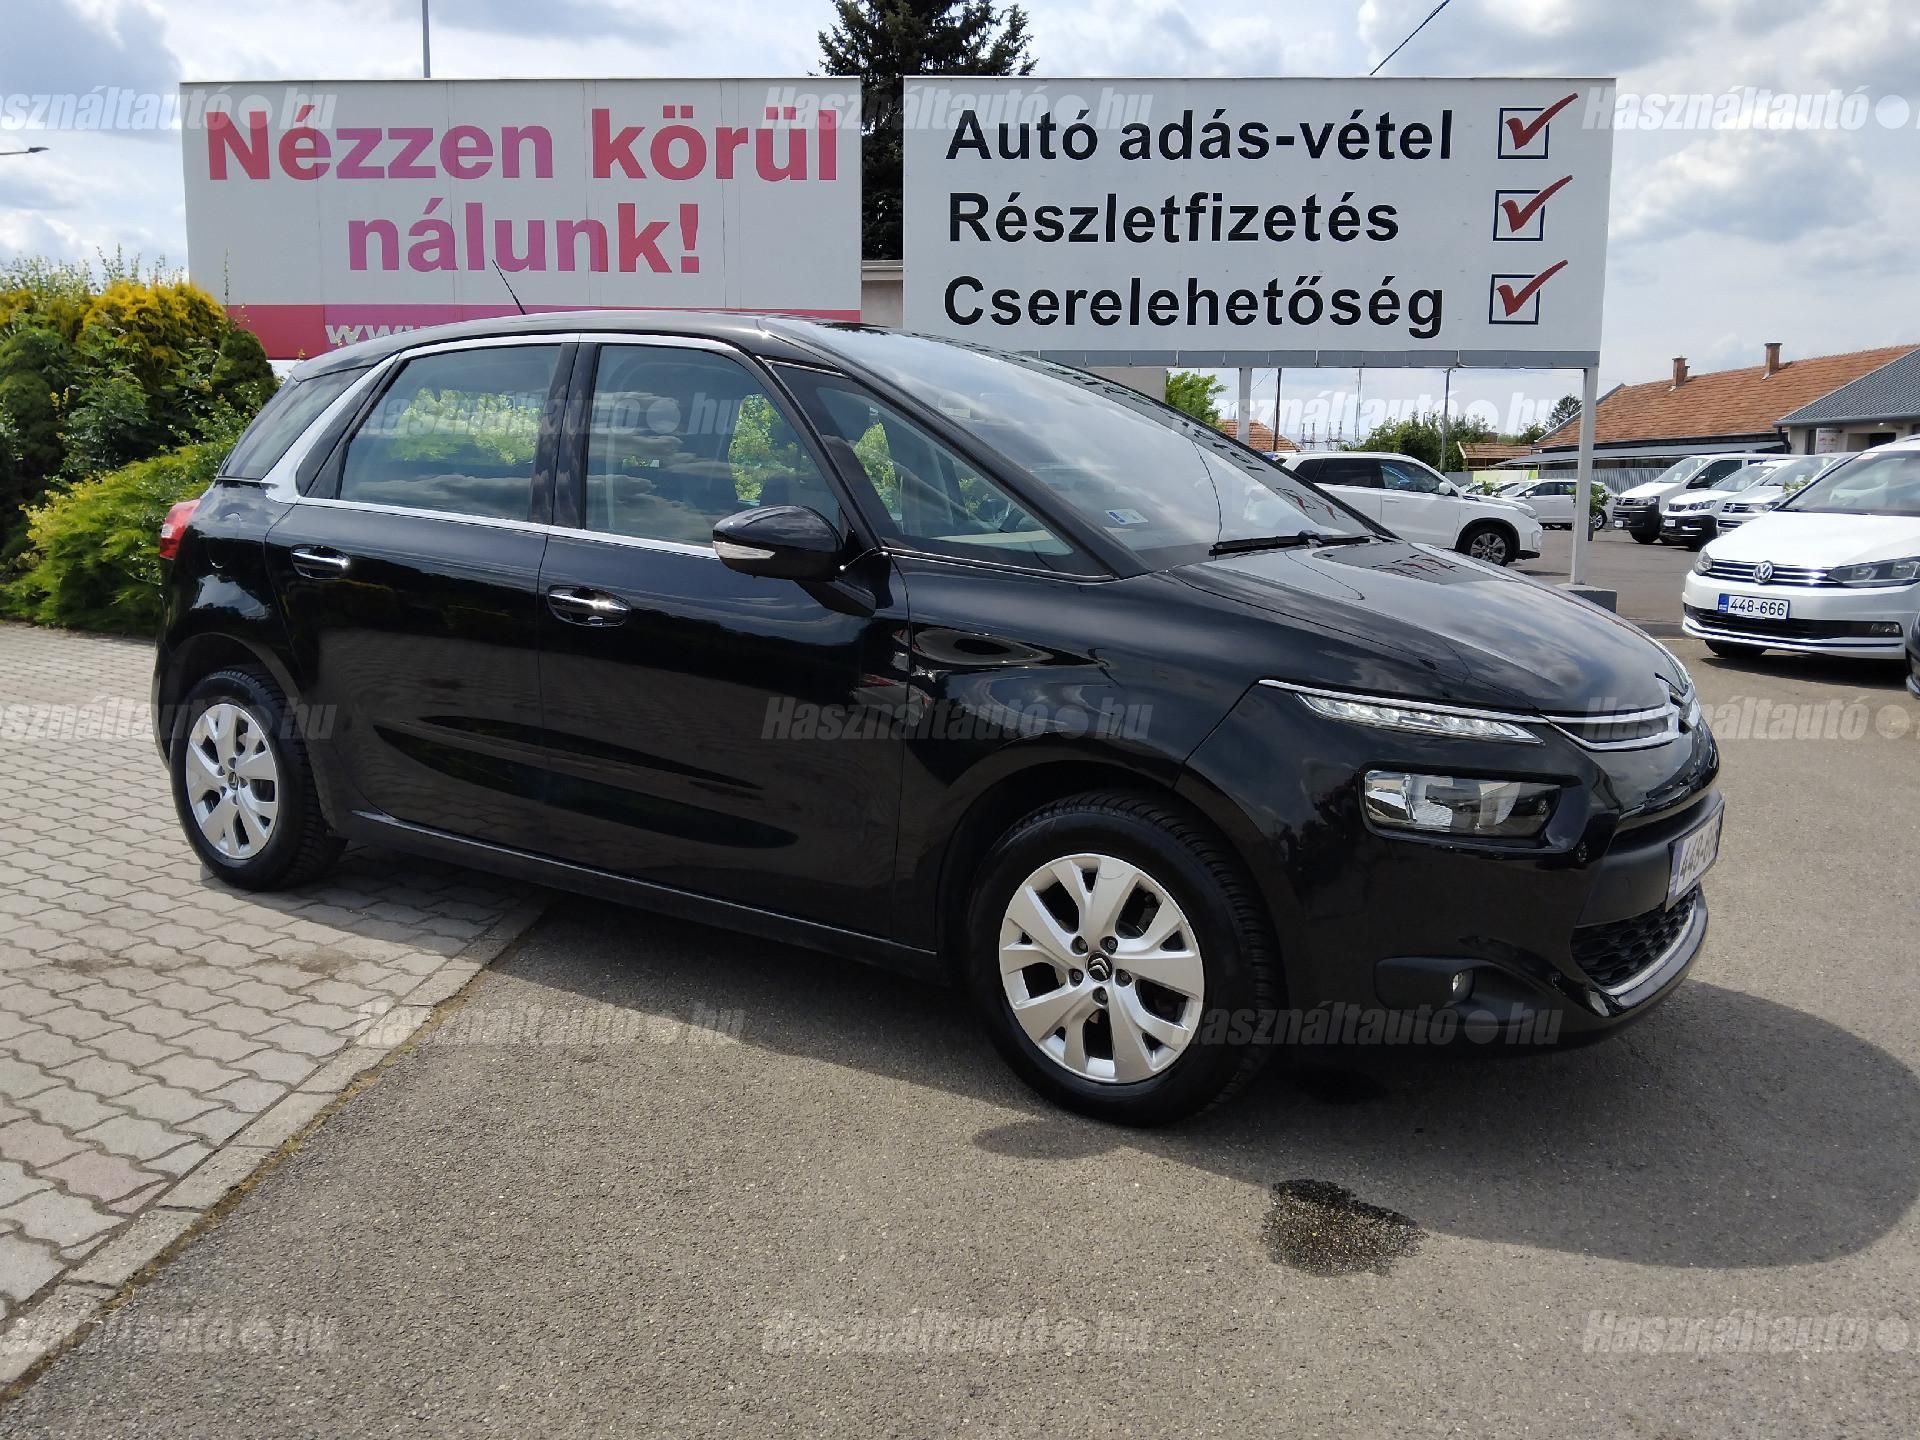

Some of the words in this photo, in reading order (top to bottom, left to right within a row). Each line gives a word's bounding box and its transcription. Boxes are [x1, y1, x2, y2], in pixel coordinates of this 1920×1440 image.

[207, 105, 553, 181] Nézzen
[592, 105, 837, 182] körül
[946, 109, 1098, 161] Autó
[1120, 108, 1453, 161] adás-vétel
[348, 197, 700, 274] nálunk!
[948, 192, 1399, 243] Részletfizetés
[944, 275, 1443, 340] Cserelehetőség
[1730, 598, 1785, 617] 448-666
